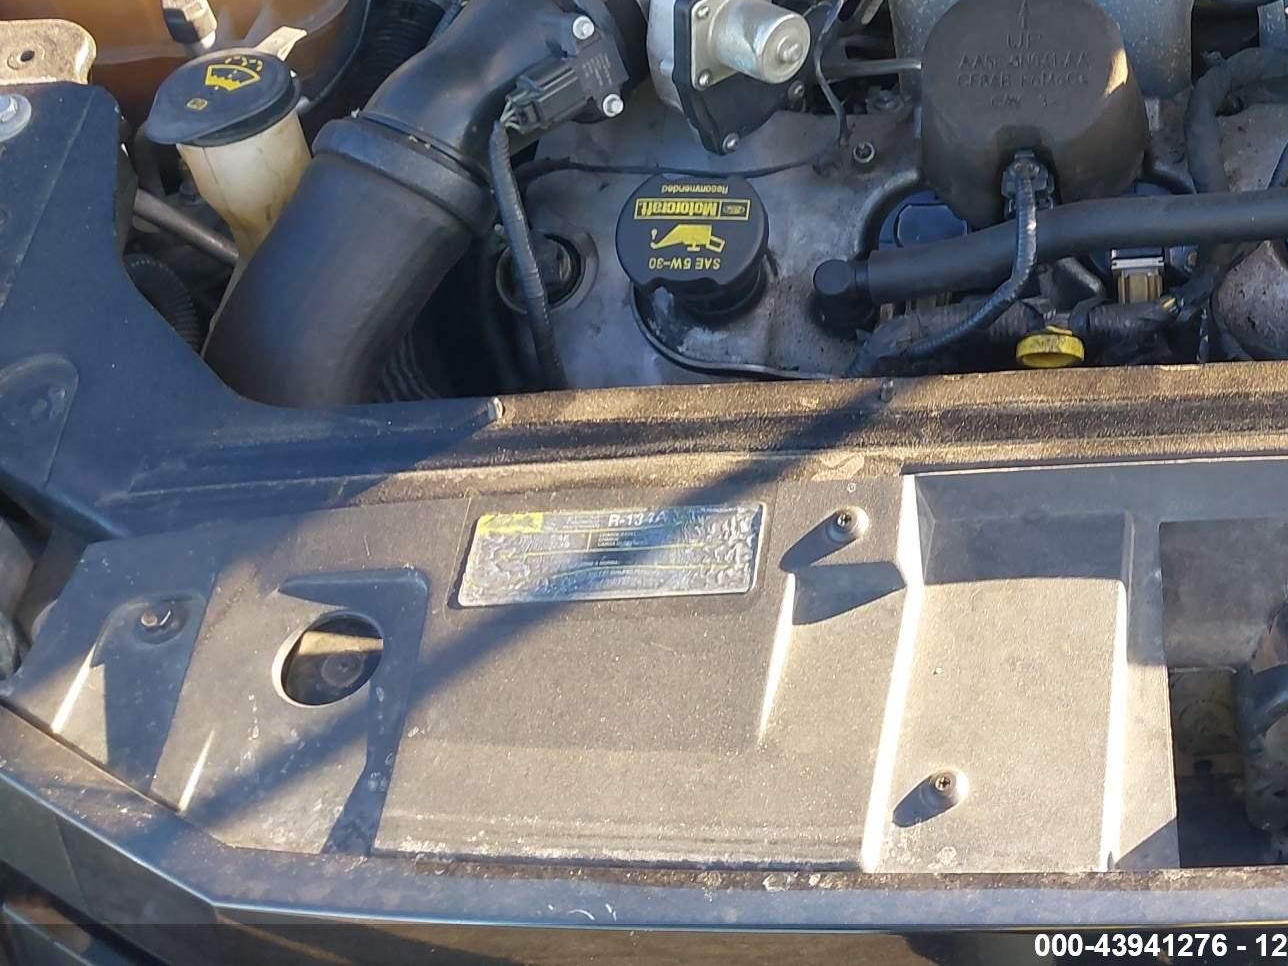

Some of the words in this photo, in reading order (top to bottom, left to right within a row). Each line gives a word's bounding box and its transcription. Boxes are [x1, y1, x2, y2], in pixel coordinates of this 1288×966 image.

[661, 185, 729, 195] Recommended
[648, 256, 692, 270] 5W-30
[694, 257, 721, 270] SAE
